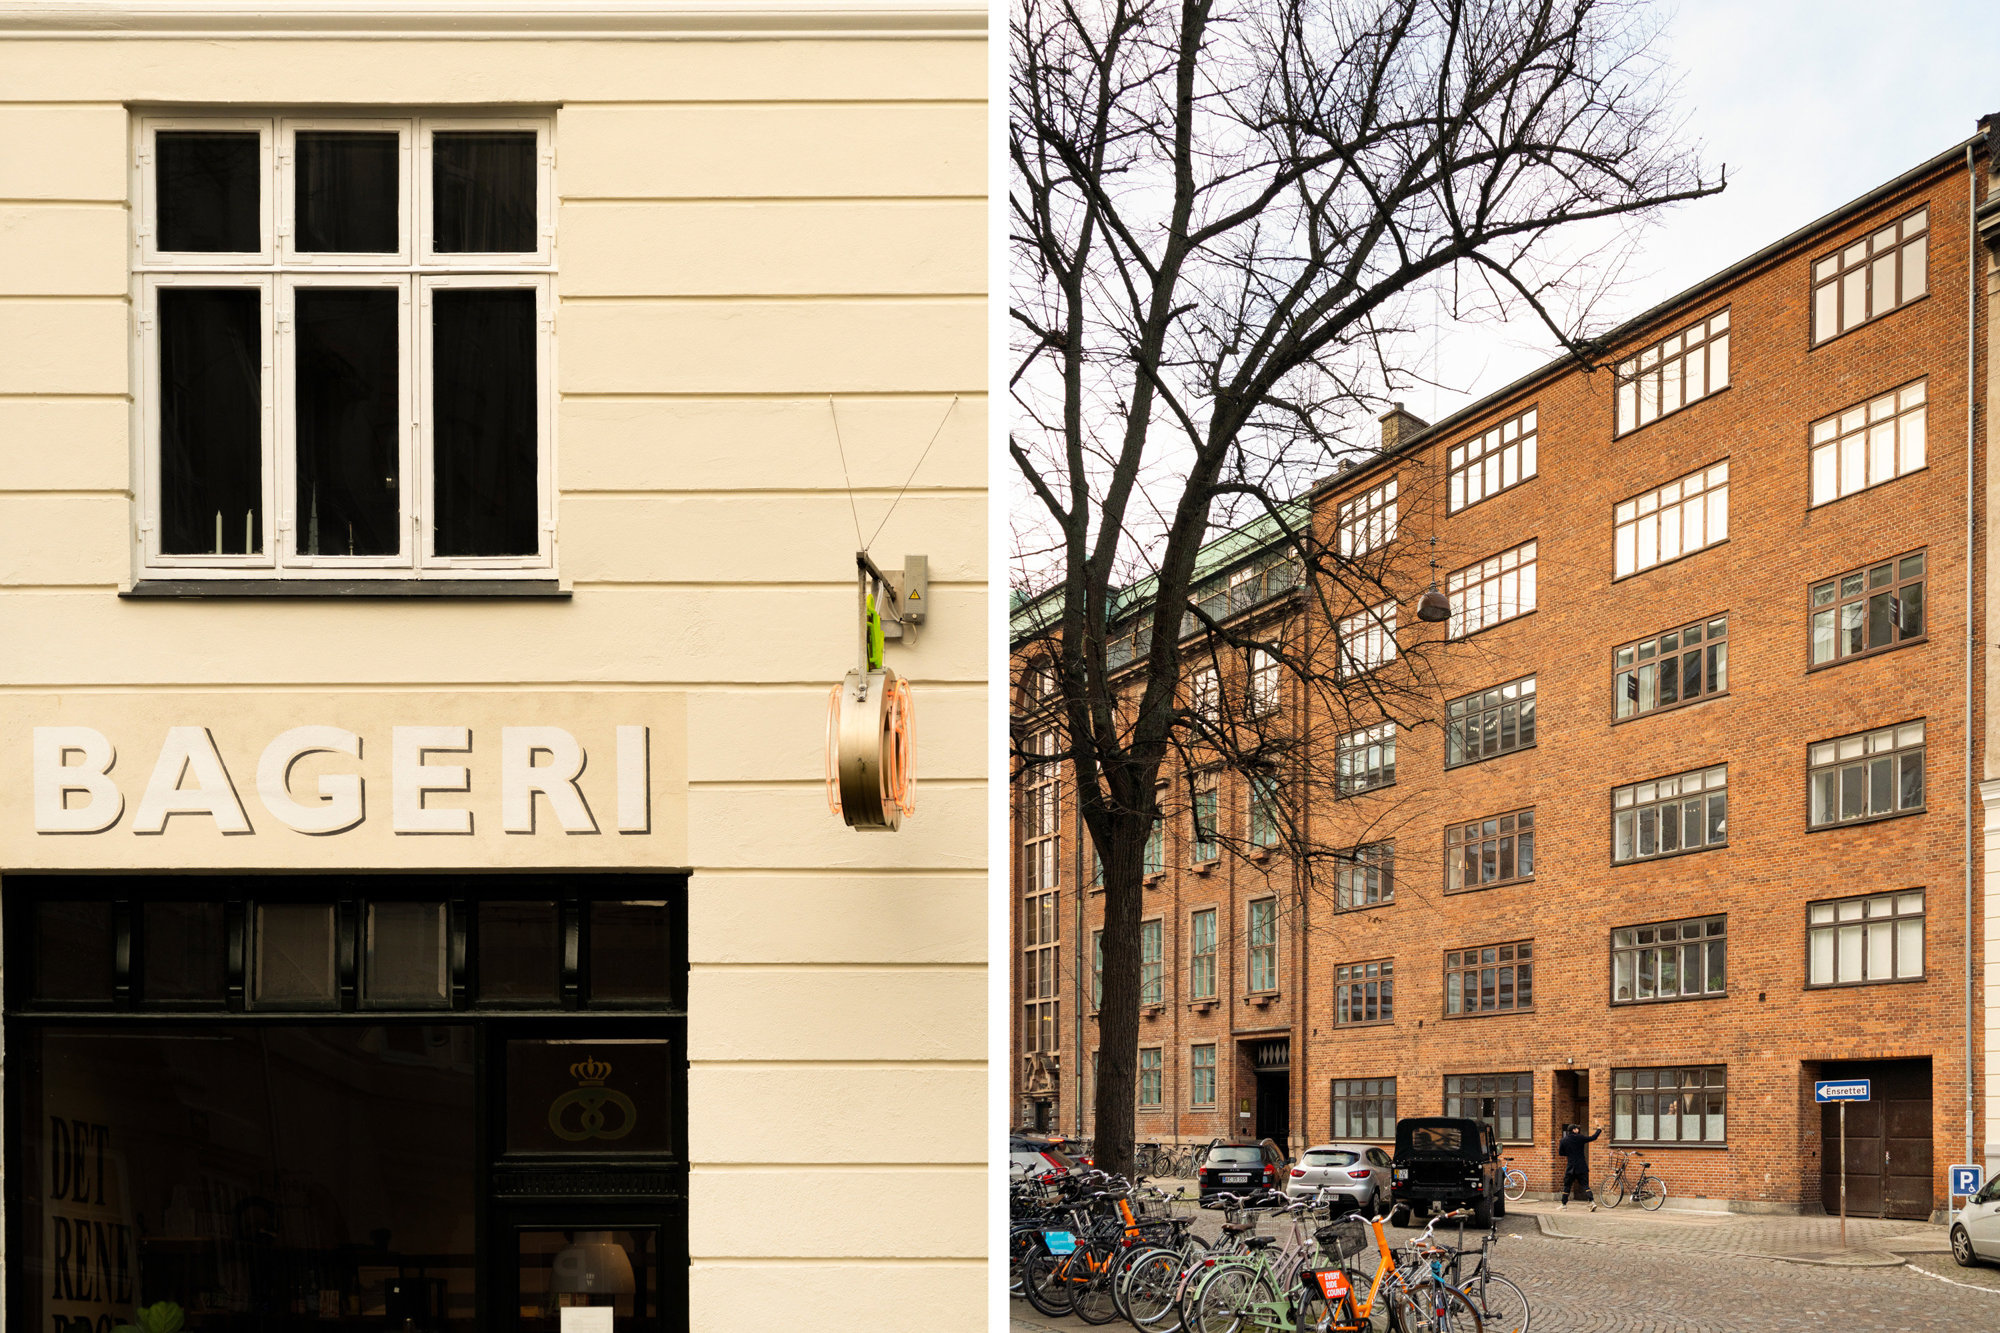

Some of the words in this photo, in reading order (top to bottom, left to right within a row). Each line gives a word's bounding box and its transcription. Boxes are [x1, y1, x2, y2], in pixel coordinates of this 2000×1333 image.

[33, 726, 651, 836] BAGERI
[1826, 1087, 1865, 1095] Ensrettet
[50, 1116, 110, 1206] DET
[1960, 1171, 1974, 1190] P
[52, 1215, 133, 1304] RENE
[1324, 1272, 1340, 1281] EVERY
[1325, 1280, 1338, 1289] RIDE
[1326, 1287, 1347, 1297] COUNTS
